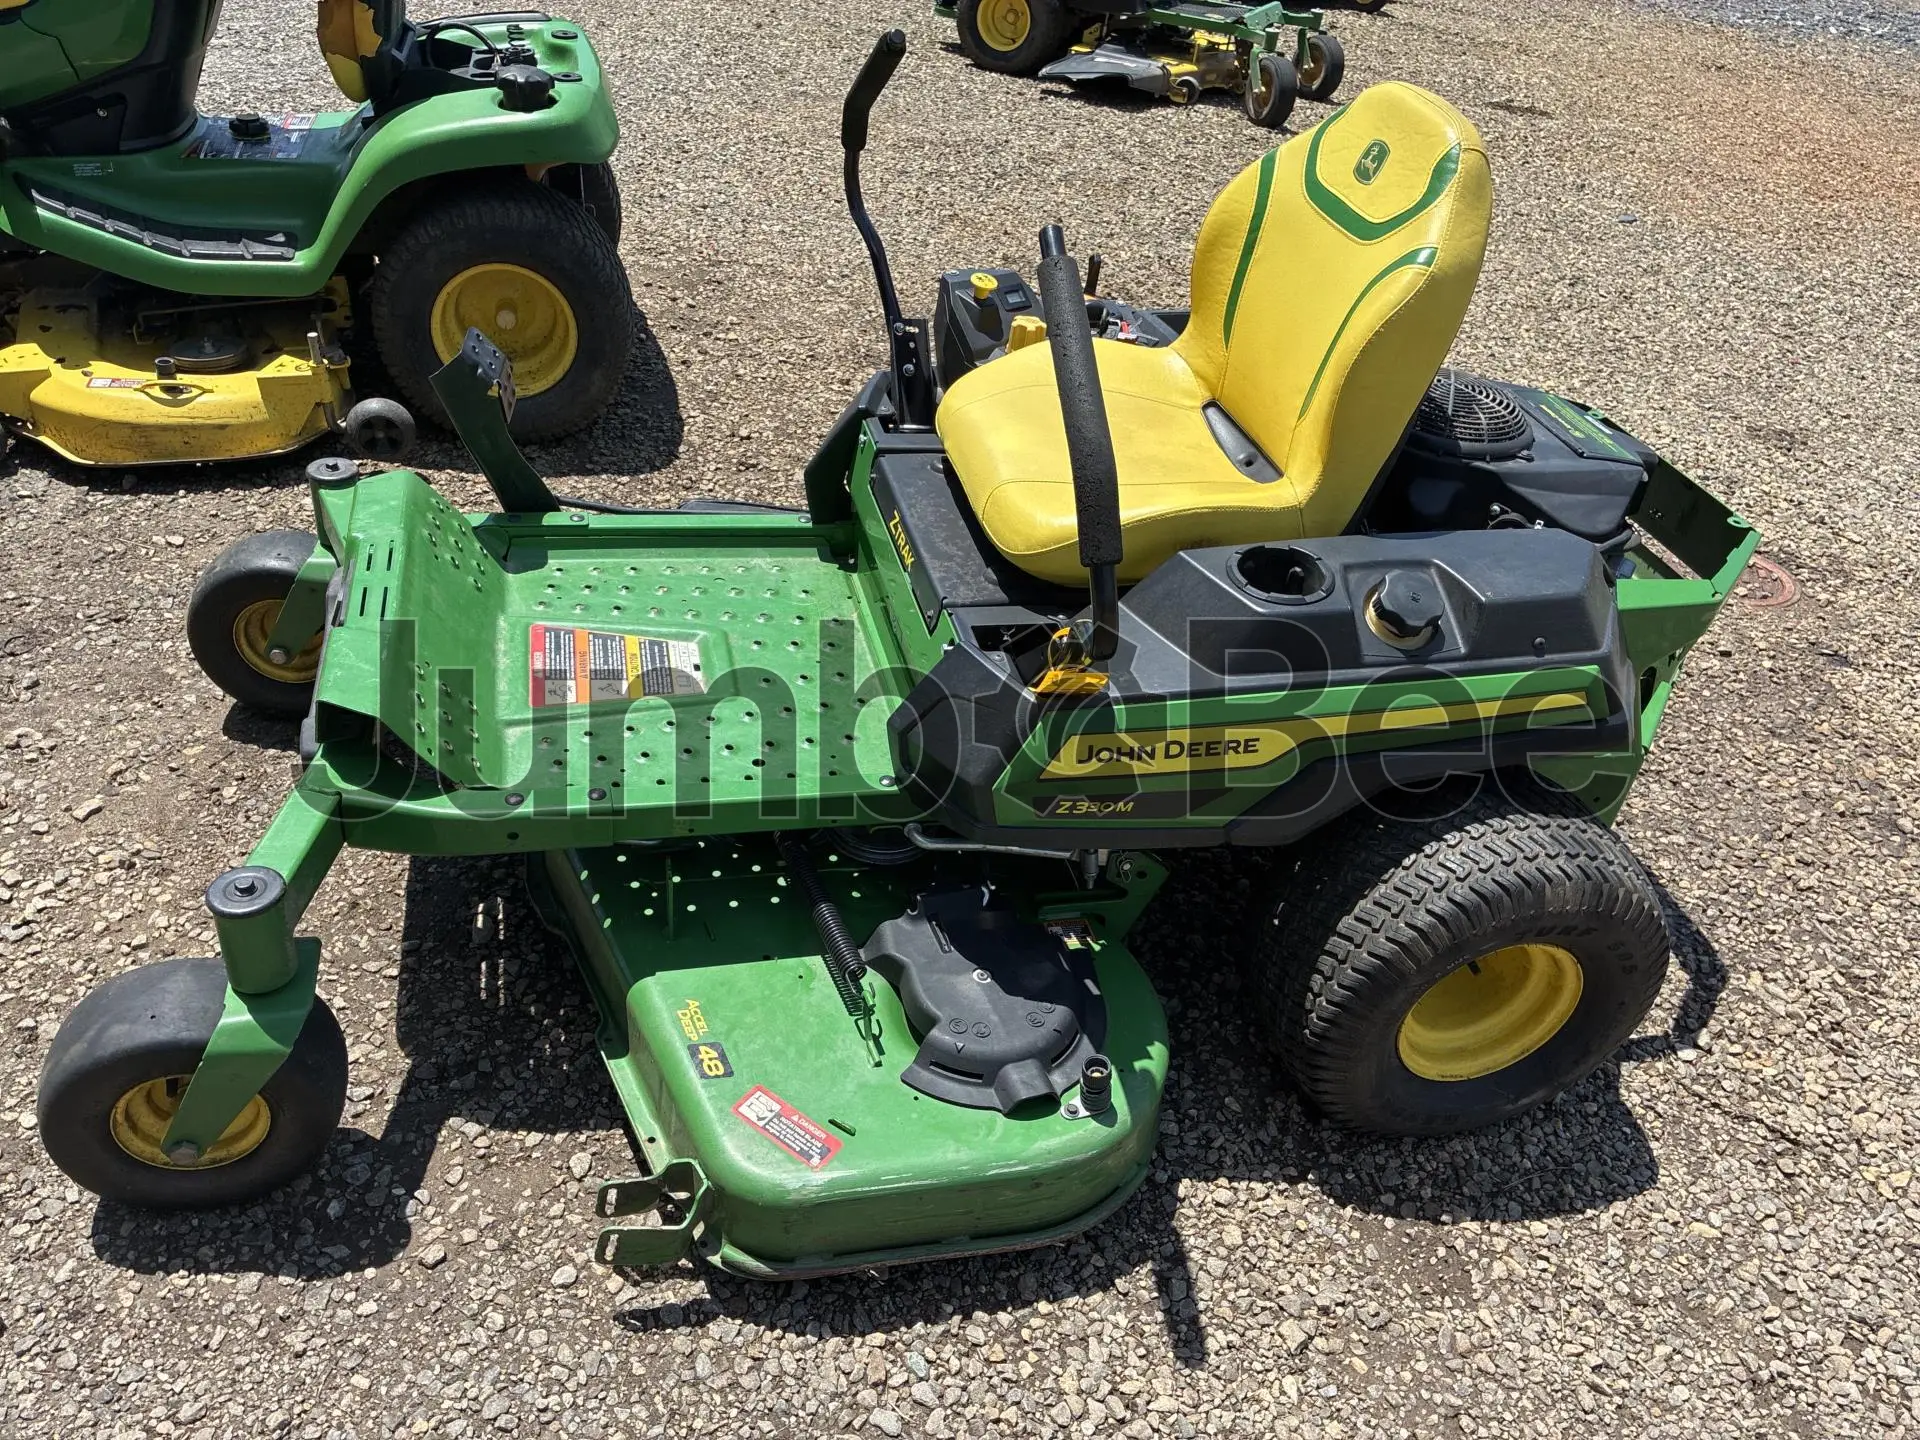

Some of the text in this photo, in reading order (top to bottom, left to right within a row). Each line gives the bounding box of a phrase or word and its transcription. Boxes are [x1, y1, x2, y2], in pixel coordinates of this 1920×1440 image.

[889, 509, 914, 573] ZTRAK
[1078, 738, 1260, 765] JOHN DEERE
[677, 1009, 699, 1041] DEEP
[685, 999, 709, 1036] ACCEL
[698, 1045, 724, 1076] 48
[798, 1118, 827, 1140] DANGER
